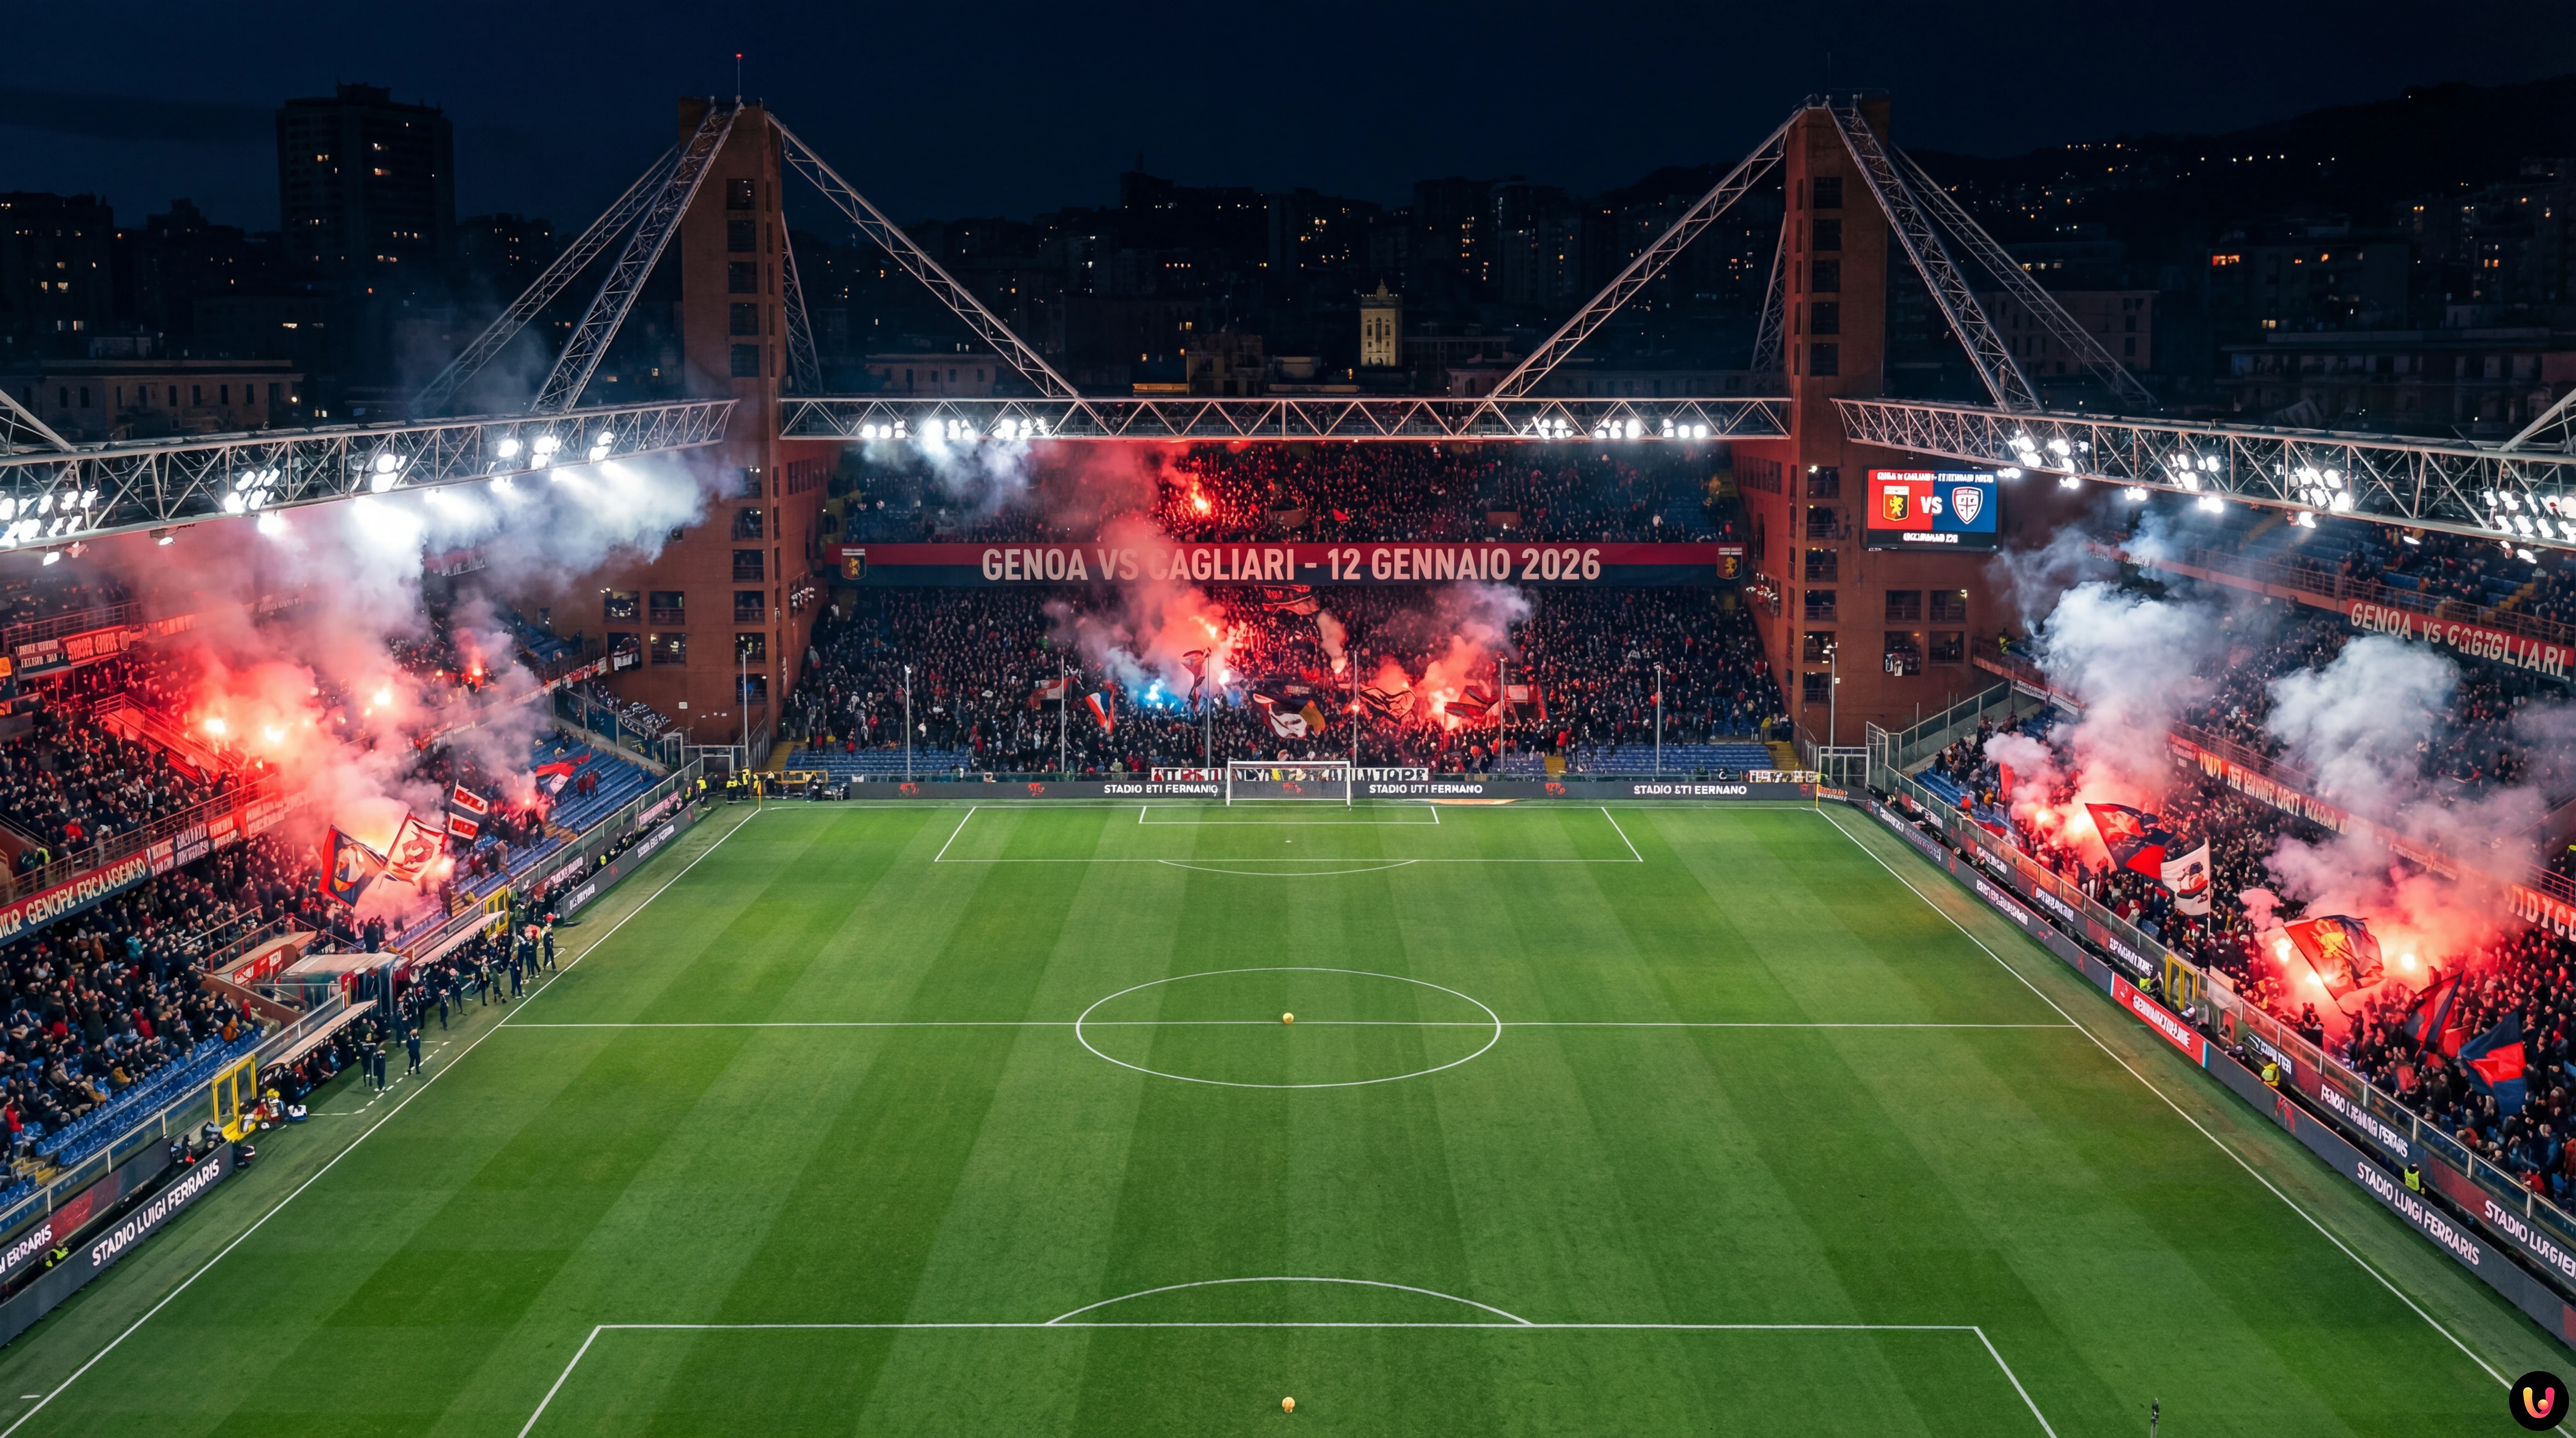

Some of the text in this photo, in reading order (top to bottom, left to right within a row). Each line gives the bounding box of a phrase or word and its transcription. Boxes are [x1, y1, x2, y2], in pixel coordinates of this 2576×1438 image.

[1920, 496, 1943, 515] VS
[982, 548, 1088, 580] GENOA
[1097, 548, 1138, 580] VS
[1149, 548, 1294, 580] CAGLIARI
[1327, 548, 1361, 580] 12
[1371, 548, 1511, 580] GENNAIO
[1521, 548, 1601, 580] 2026
[2351, 602, 2412, 640] GENOA
[2422, 621, 2441, 643] VS
[1104, 784, 1142, 794] STADIO
[1369, 784, 1407, 793] STADIO
[1634, 785, 1672, 794] STADIO
[92, 1159, 220, 1266] STADIO LUIGI FERRARIS
[2357, 1162, 2480, 1265] STADIO LUIGI FERRARIS
[2485, 1200, 2528, 1243] STADIO
